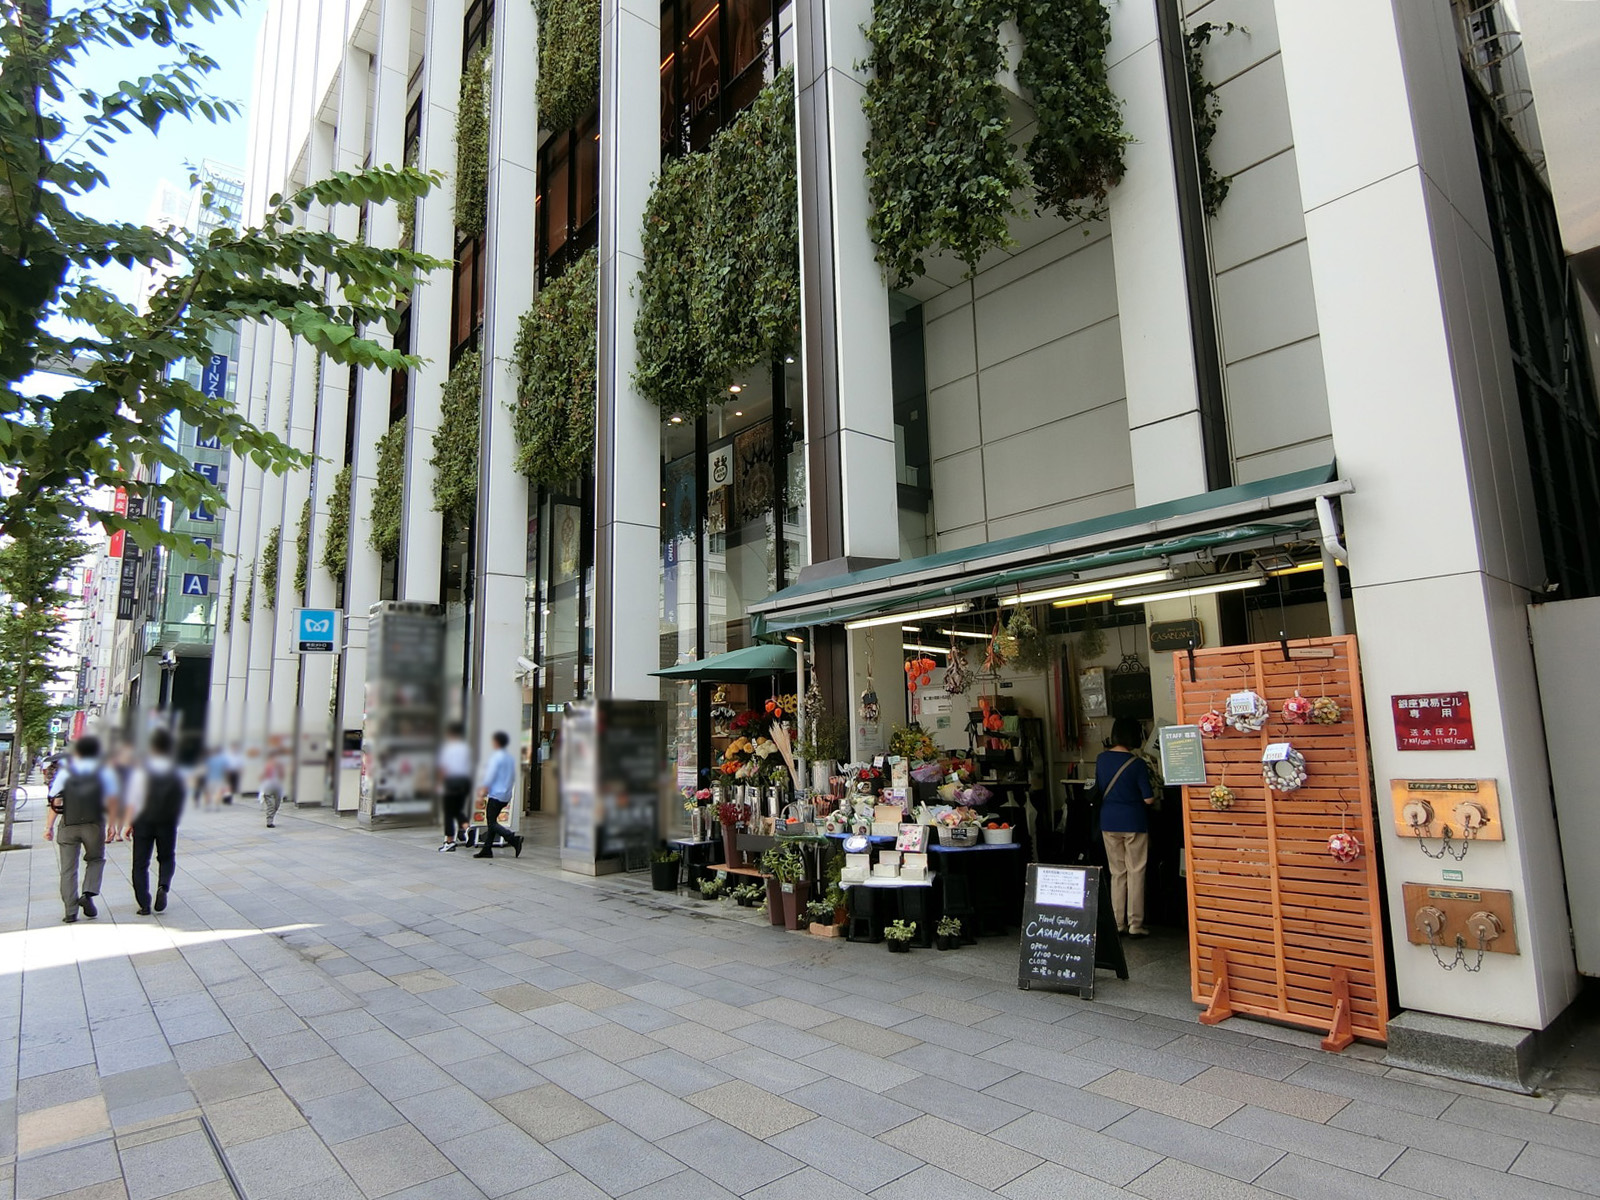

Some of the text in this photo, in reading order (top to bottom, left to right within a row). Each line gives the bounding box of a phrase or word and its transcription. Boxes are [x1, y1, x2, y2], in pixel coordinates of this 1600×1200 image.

[208, 355, 221, 400] GINZA
[1398, 697, 1462, 709] 銀座貿易ビル
[1056, 916, 1079, 928] Gallery
[1030, 942, 1048, 950] OPEN
[1028, 958, 1047, 966] CLOSE
